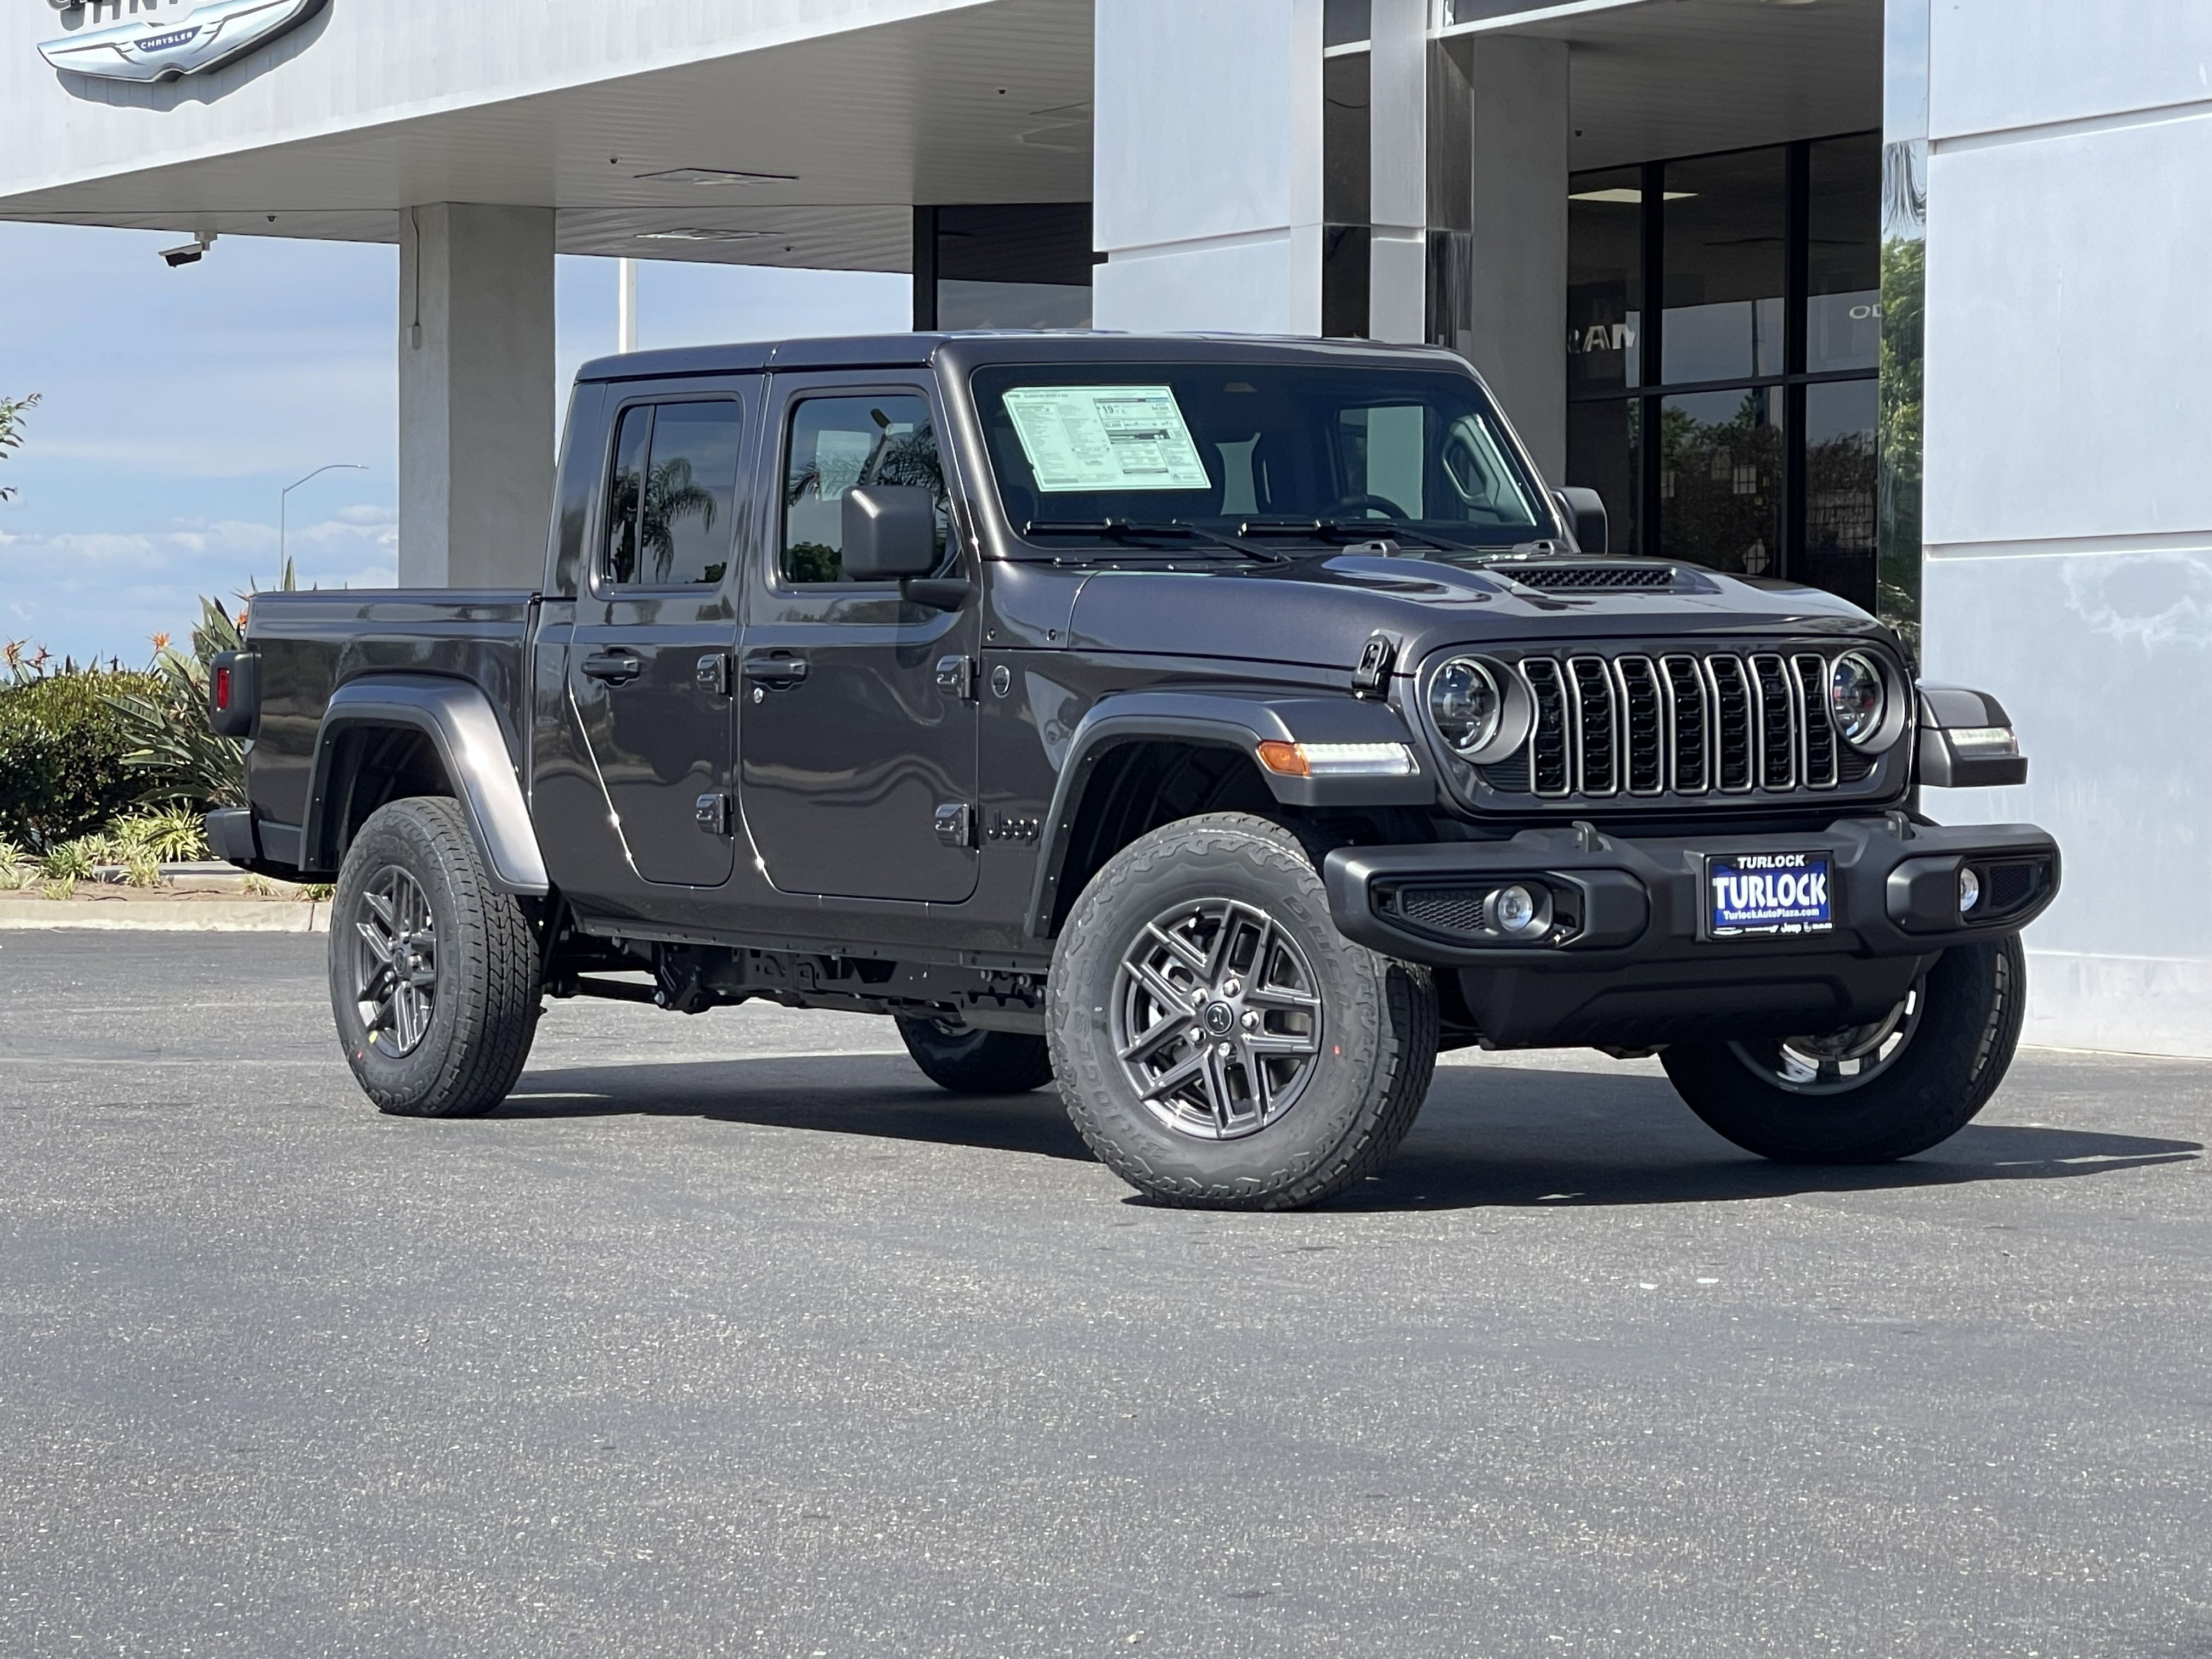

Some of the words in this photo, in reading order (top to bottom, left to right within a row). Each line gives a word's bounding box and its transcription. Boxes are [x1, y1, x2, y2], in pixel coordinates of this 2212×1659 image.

[141, 32, 193, 49] CHRYSLER
[1737, 855, 1805, 869] TURLOCK
[1712, 872, 1827, 909] TURLOCK
[1723, 909, 1820, 920] TurlockAutoPlaza.com
[1781, 922, 1802, 934] Jeep
